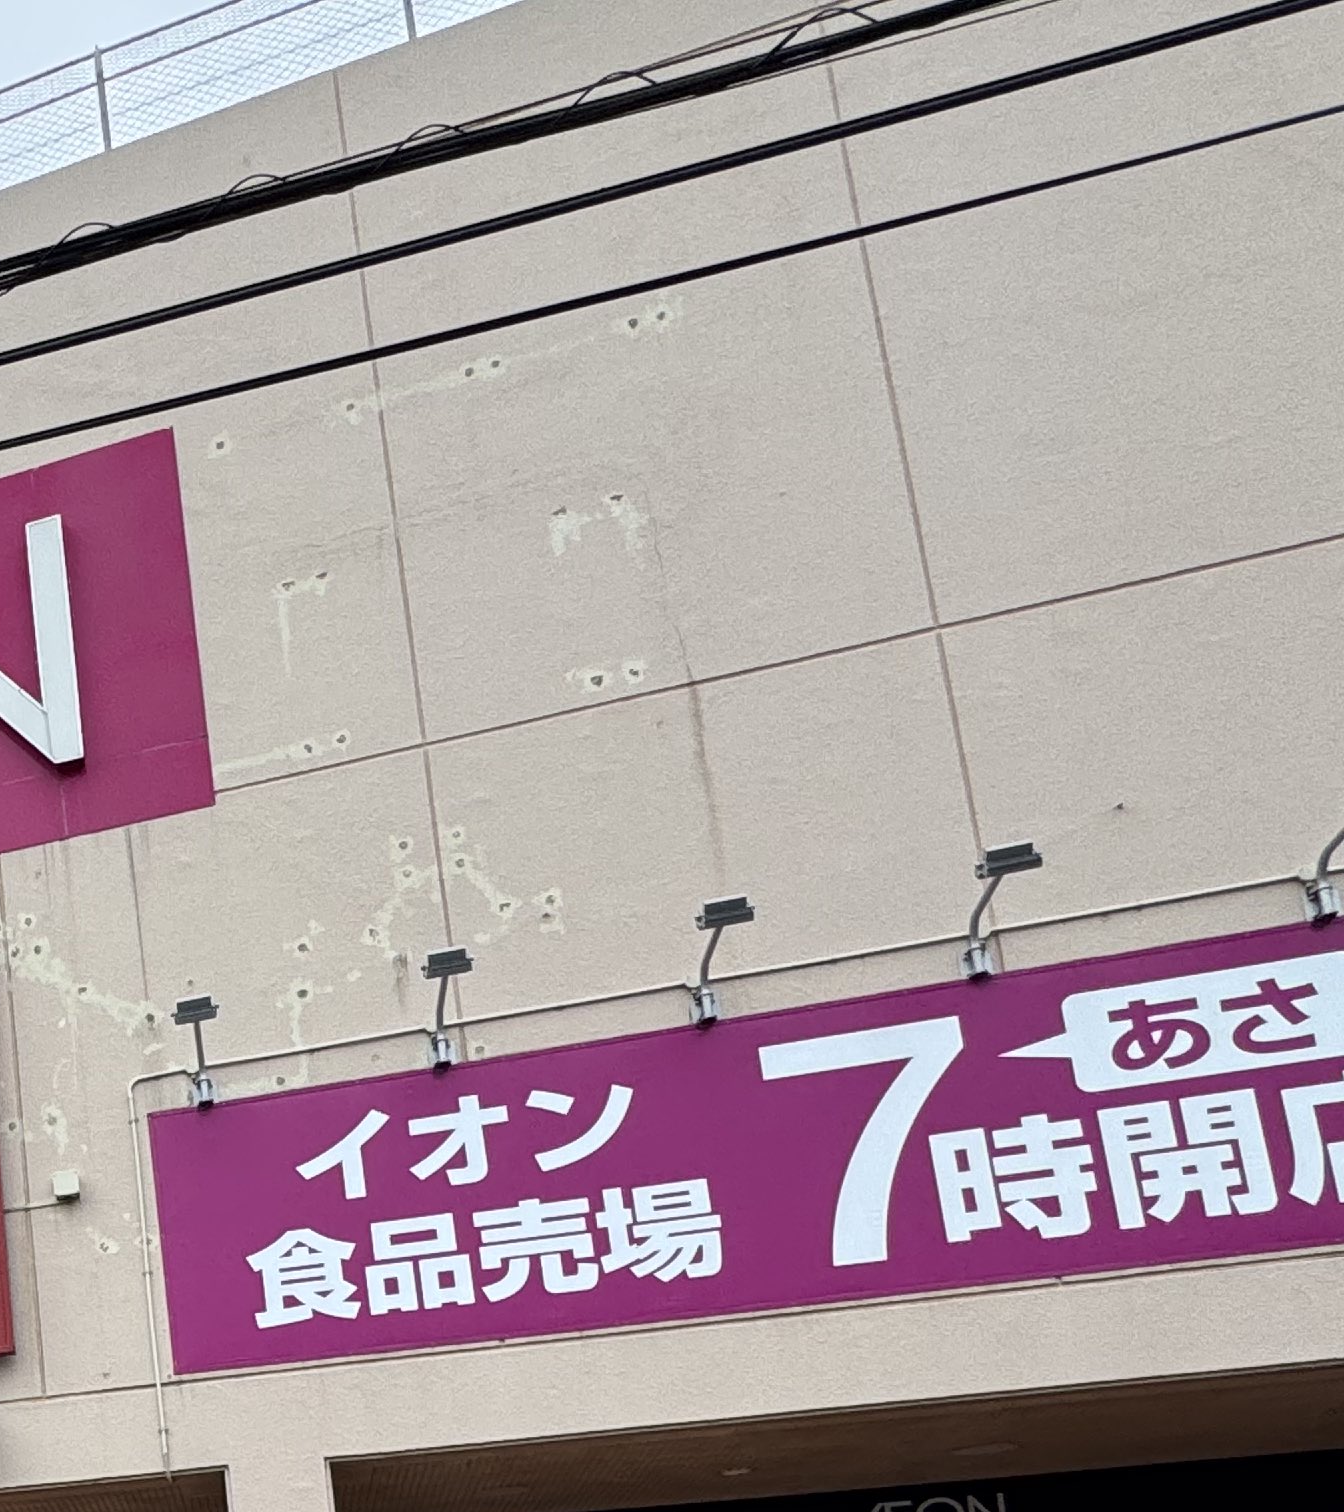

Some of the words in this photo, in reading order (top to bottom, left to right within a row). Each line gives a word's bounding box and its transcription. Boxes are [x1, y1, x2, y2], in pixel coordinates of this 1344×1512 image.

[1109, 978, 1320, 1072] あさ
[295, 1083, 634, 1200] イオン
[245, 1177, 724, 1329] 食品売場
